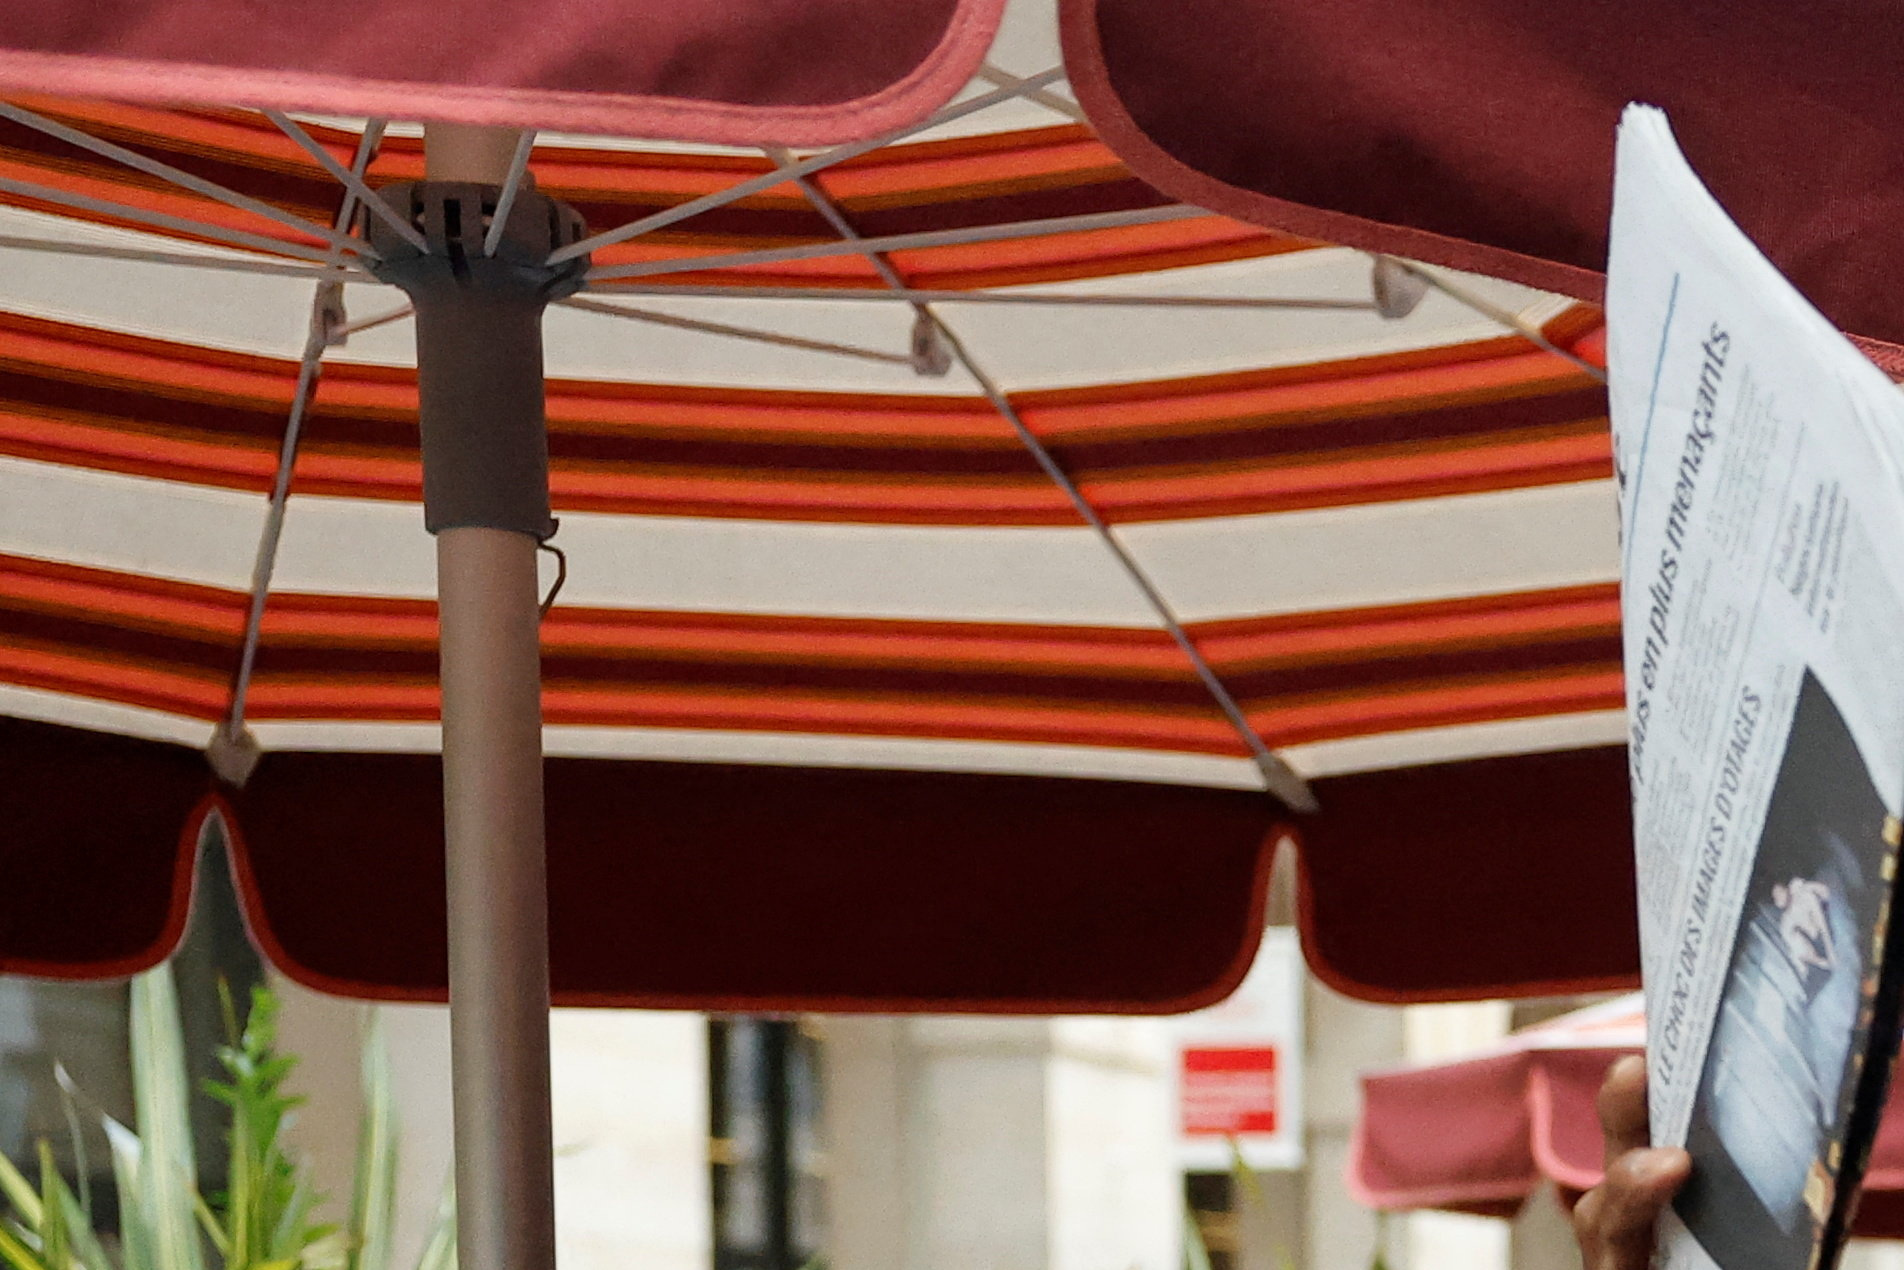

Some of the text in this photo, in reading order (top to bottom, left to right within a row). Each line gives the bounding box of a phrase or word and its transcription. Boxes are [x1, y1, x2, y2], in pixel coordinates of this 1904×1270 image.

[1641, 320, 1731, 691] en plus menaçants
